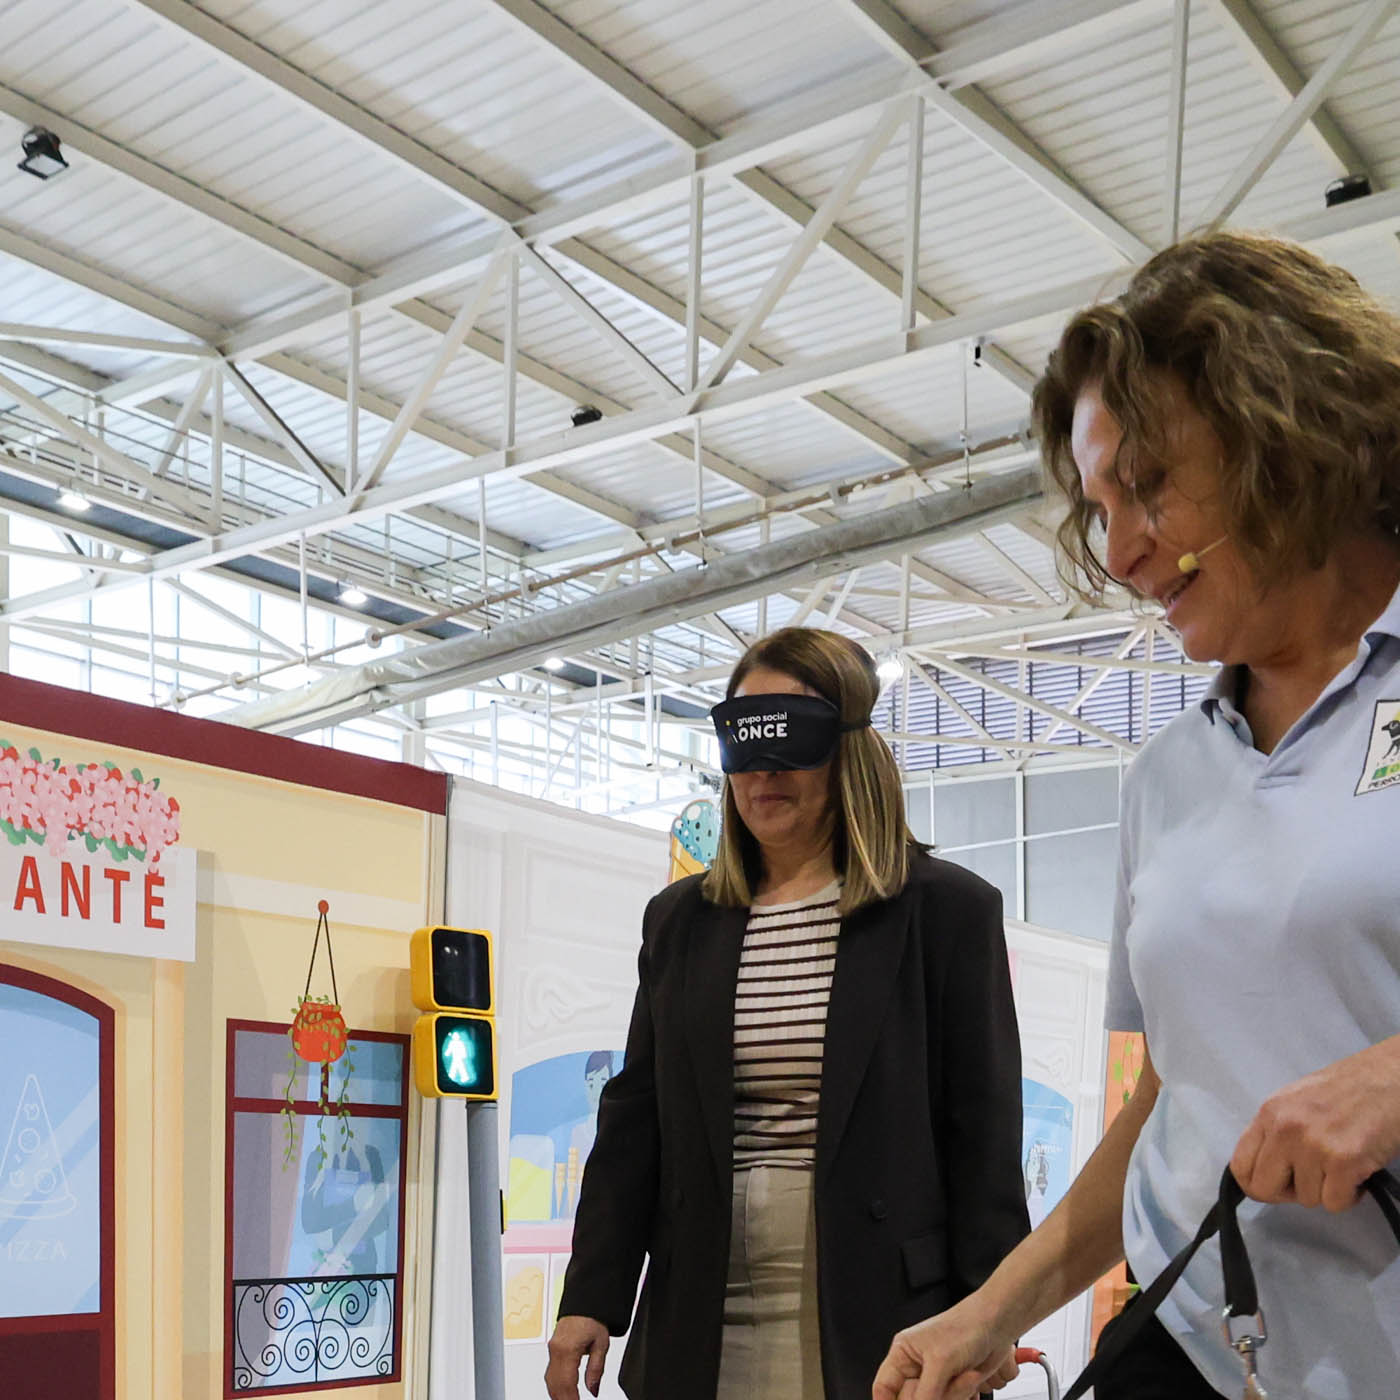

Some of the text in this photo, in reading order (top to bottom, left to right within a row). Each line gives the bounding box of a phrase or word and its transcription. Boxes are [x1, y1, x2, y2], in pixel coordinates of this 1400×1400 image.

[737, 712, 788, 727] grupo social
[738, 723, 788, 742] ONCE
